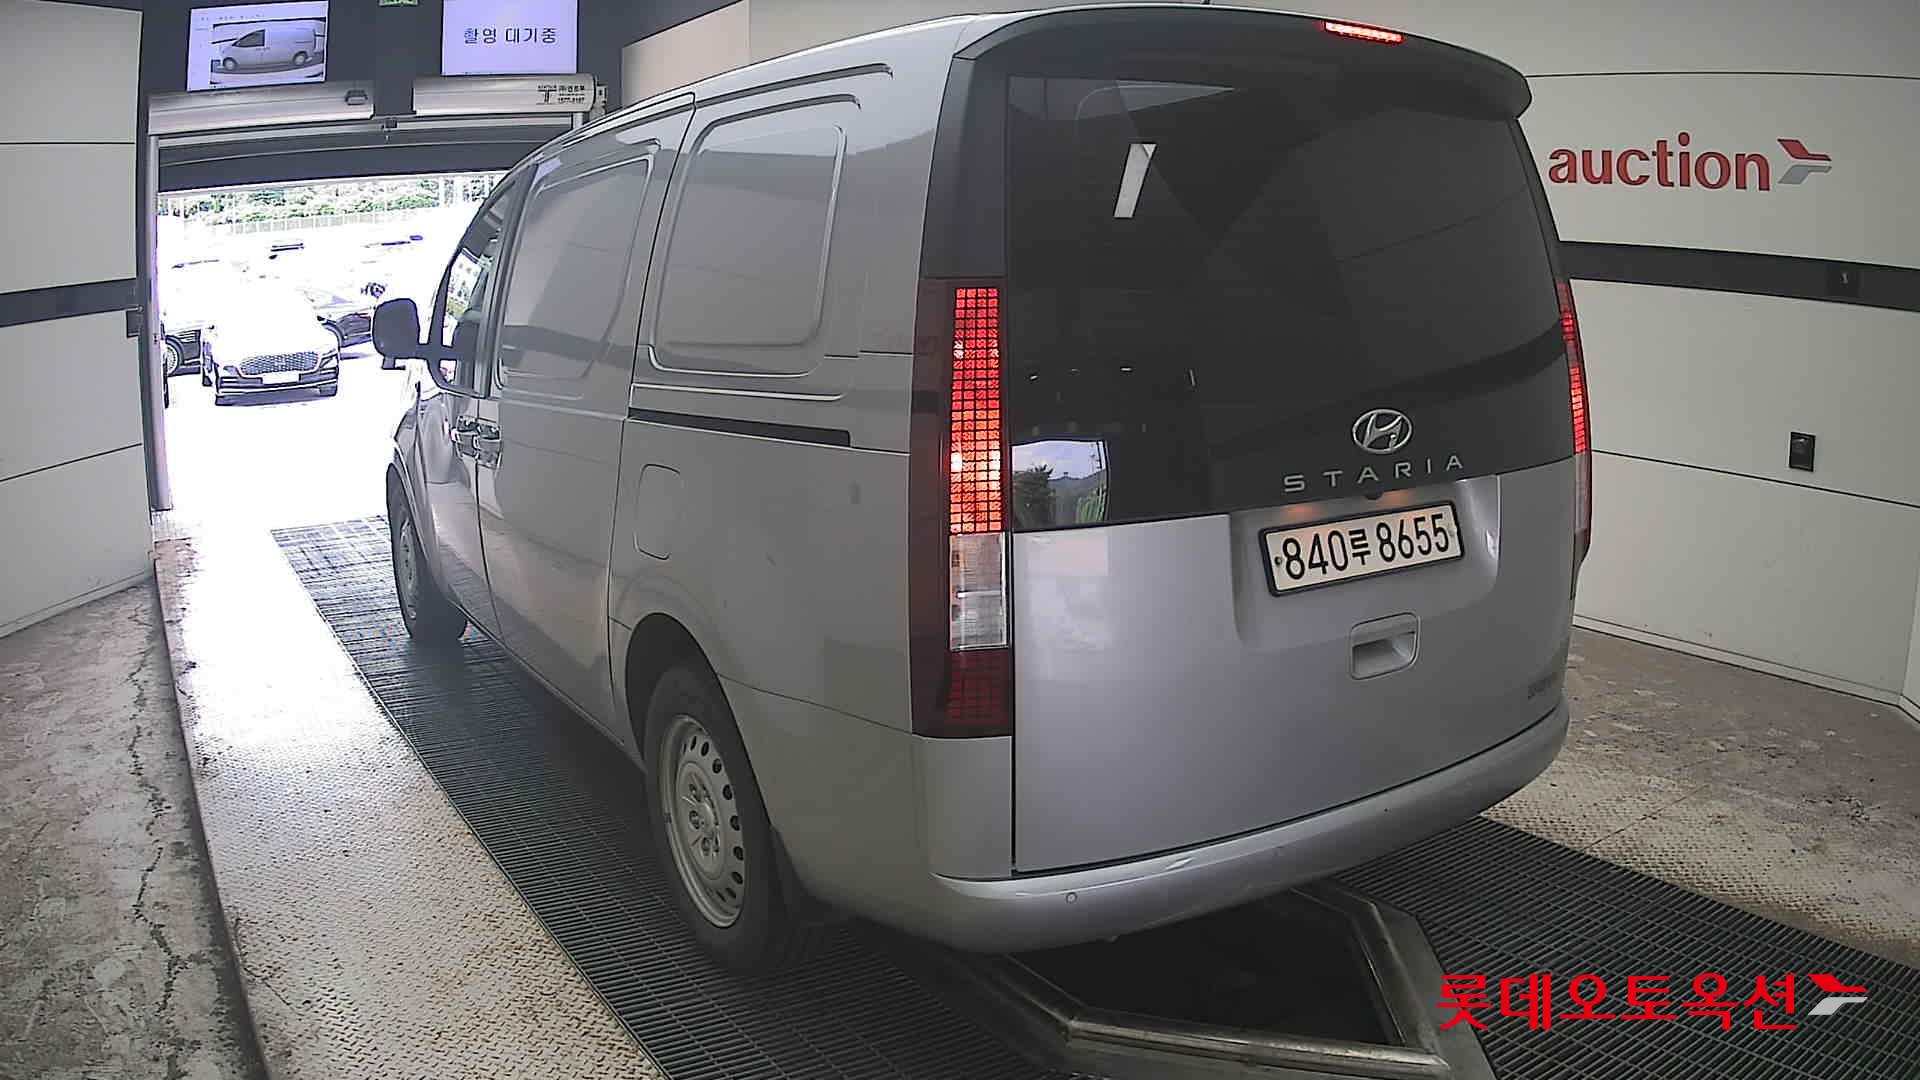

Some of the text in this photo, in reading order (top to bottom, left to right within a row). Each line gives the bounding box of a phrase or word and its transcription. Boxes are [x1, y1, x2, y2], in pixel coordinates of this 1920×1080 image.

[464, 27, 556, 44] 촬영 대기중
[1549, 131, 1770, 191] auction
[1283, 455, 1463, 492] STARIA
[1282, 513, 1449, 580] 840루 8655
